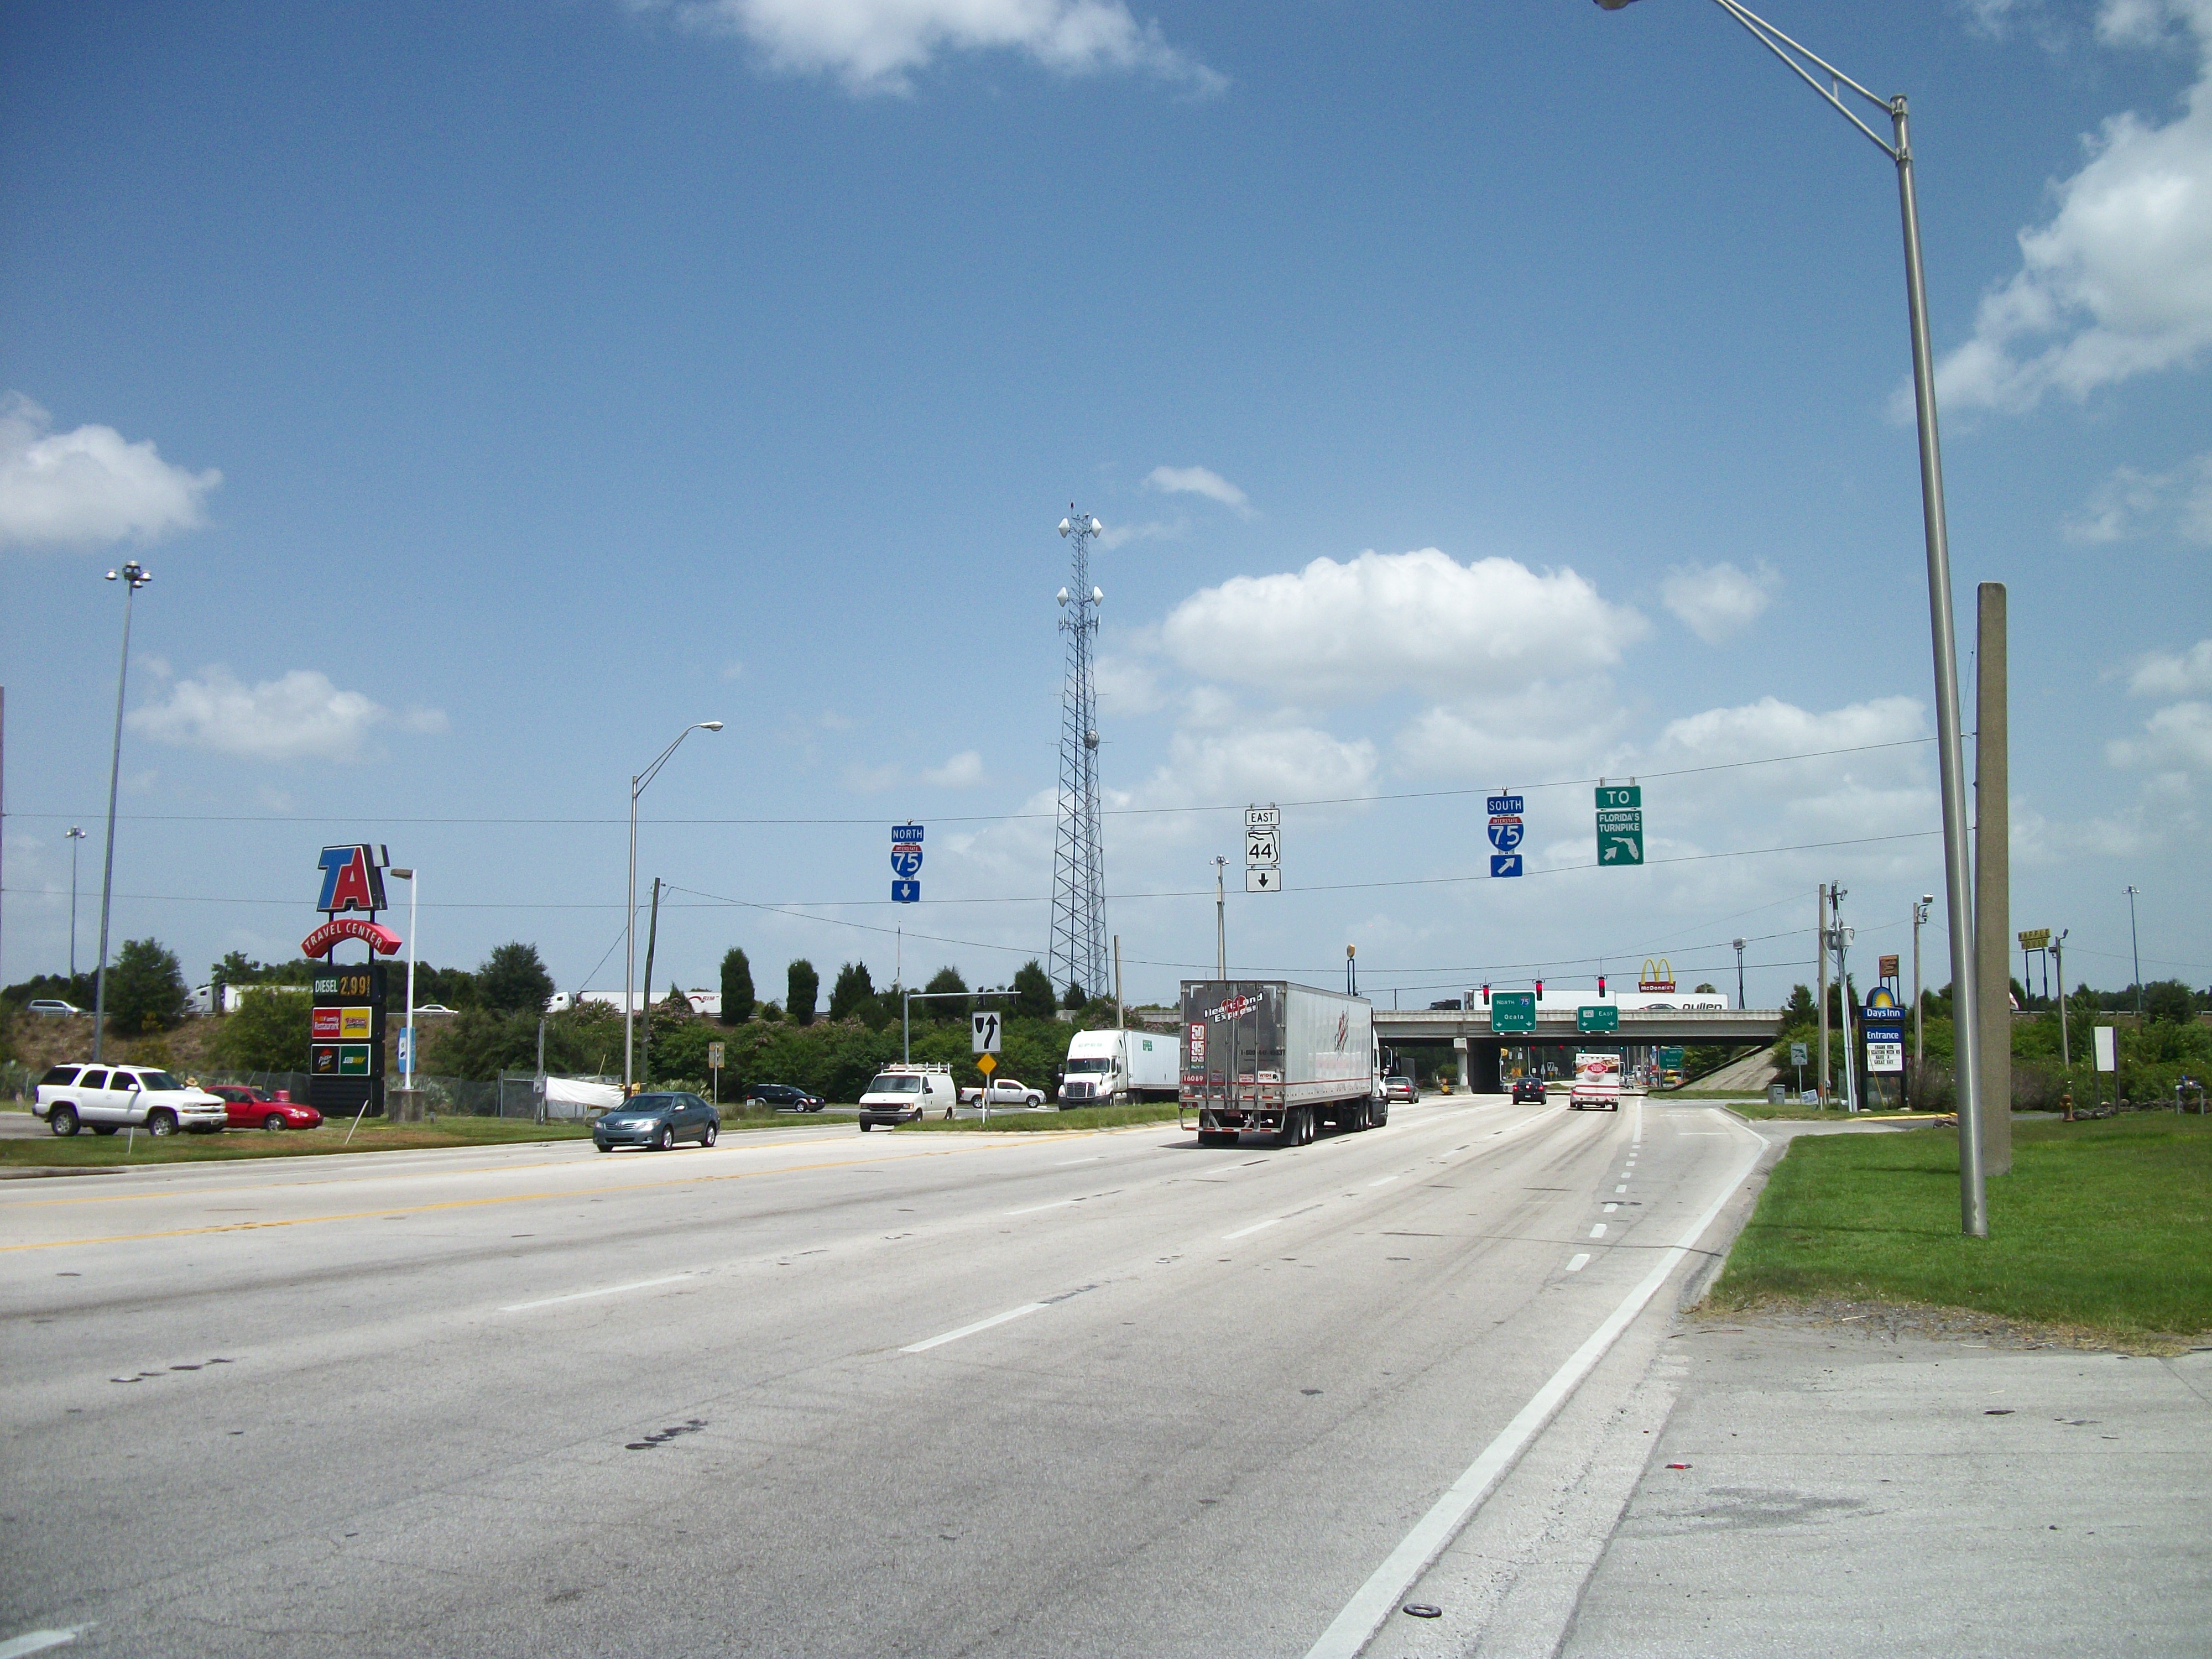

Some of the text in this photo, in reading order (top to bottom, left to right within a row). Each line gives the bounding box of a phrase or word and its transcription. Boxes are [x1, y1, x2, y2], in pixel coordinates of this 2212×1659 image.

[1606, 790, 1630, 804] TO
[1489, 800, 1521, 811] SOUTH
[1251, 812, 1274, 822] EAST
[1599, 812, 1640, 822] FLORIDA'S
[893, 829, 922, 839] NORTH
[1599, 823, 1640, 832] TURNPIKE
[1491, 825, 1520, 846] 75
[1249, 843, 1272, 859] 44
[894, 853, 919, 872] 75
[317, 847, 373, 910] TA
[305, 922, 383, 950] TRAVEL CENTER
[315, 979, 338, 993] DIESEL
[1867, 1009, 1900, 1018] Days Inn
[1191, 1025, 1204, 1040] 50
[1867, 1031, 1899, 1039] Entrance
[1191, 1041, 1204, 1056] 95
